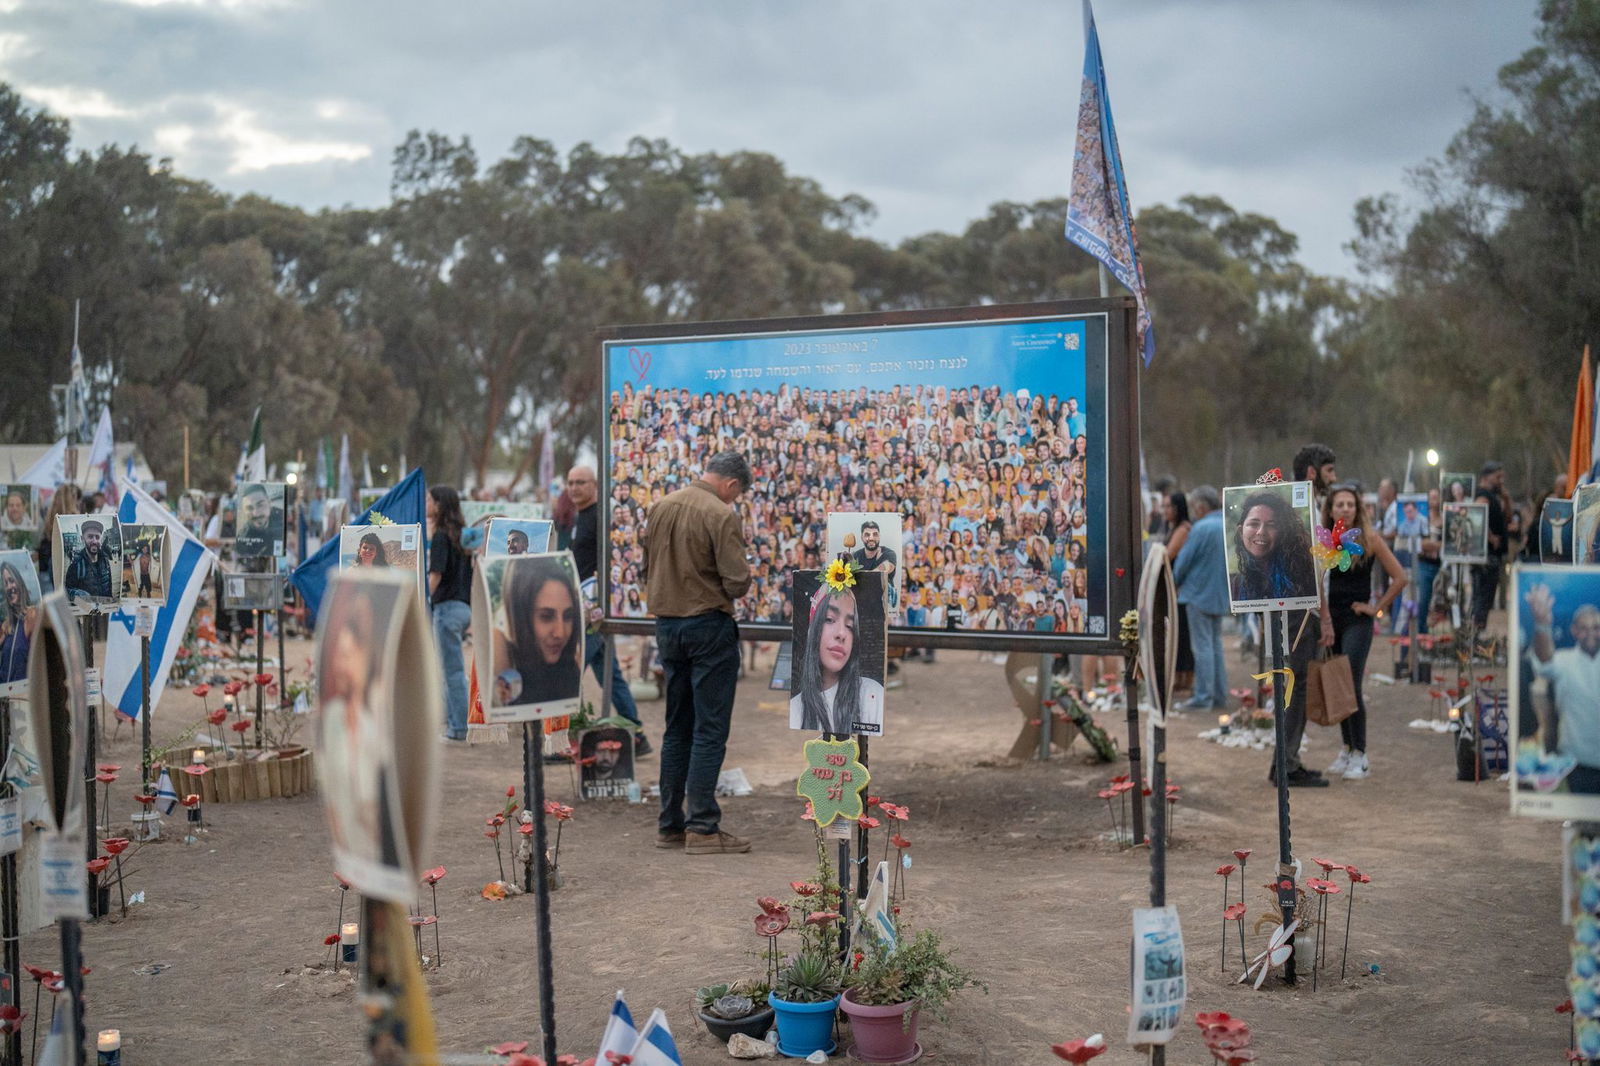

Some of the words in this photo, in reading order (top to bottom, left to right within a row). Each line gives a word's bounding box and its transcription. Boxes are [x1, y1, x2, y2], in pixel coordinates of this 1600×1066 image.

[783, 343, 811, 356] 2023
[814, 340, 869, 355] באוקטובר
[846, 363, 862, 374] עם
[905, 359, 935, 371] נזכור
[938, 355, 968, 369] לנצח
[766, 364, 811, 377] והשמחה
[823, 753, 847, 766] שני
[839, 770, 853, 785] בן
